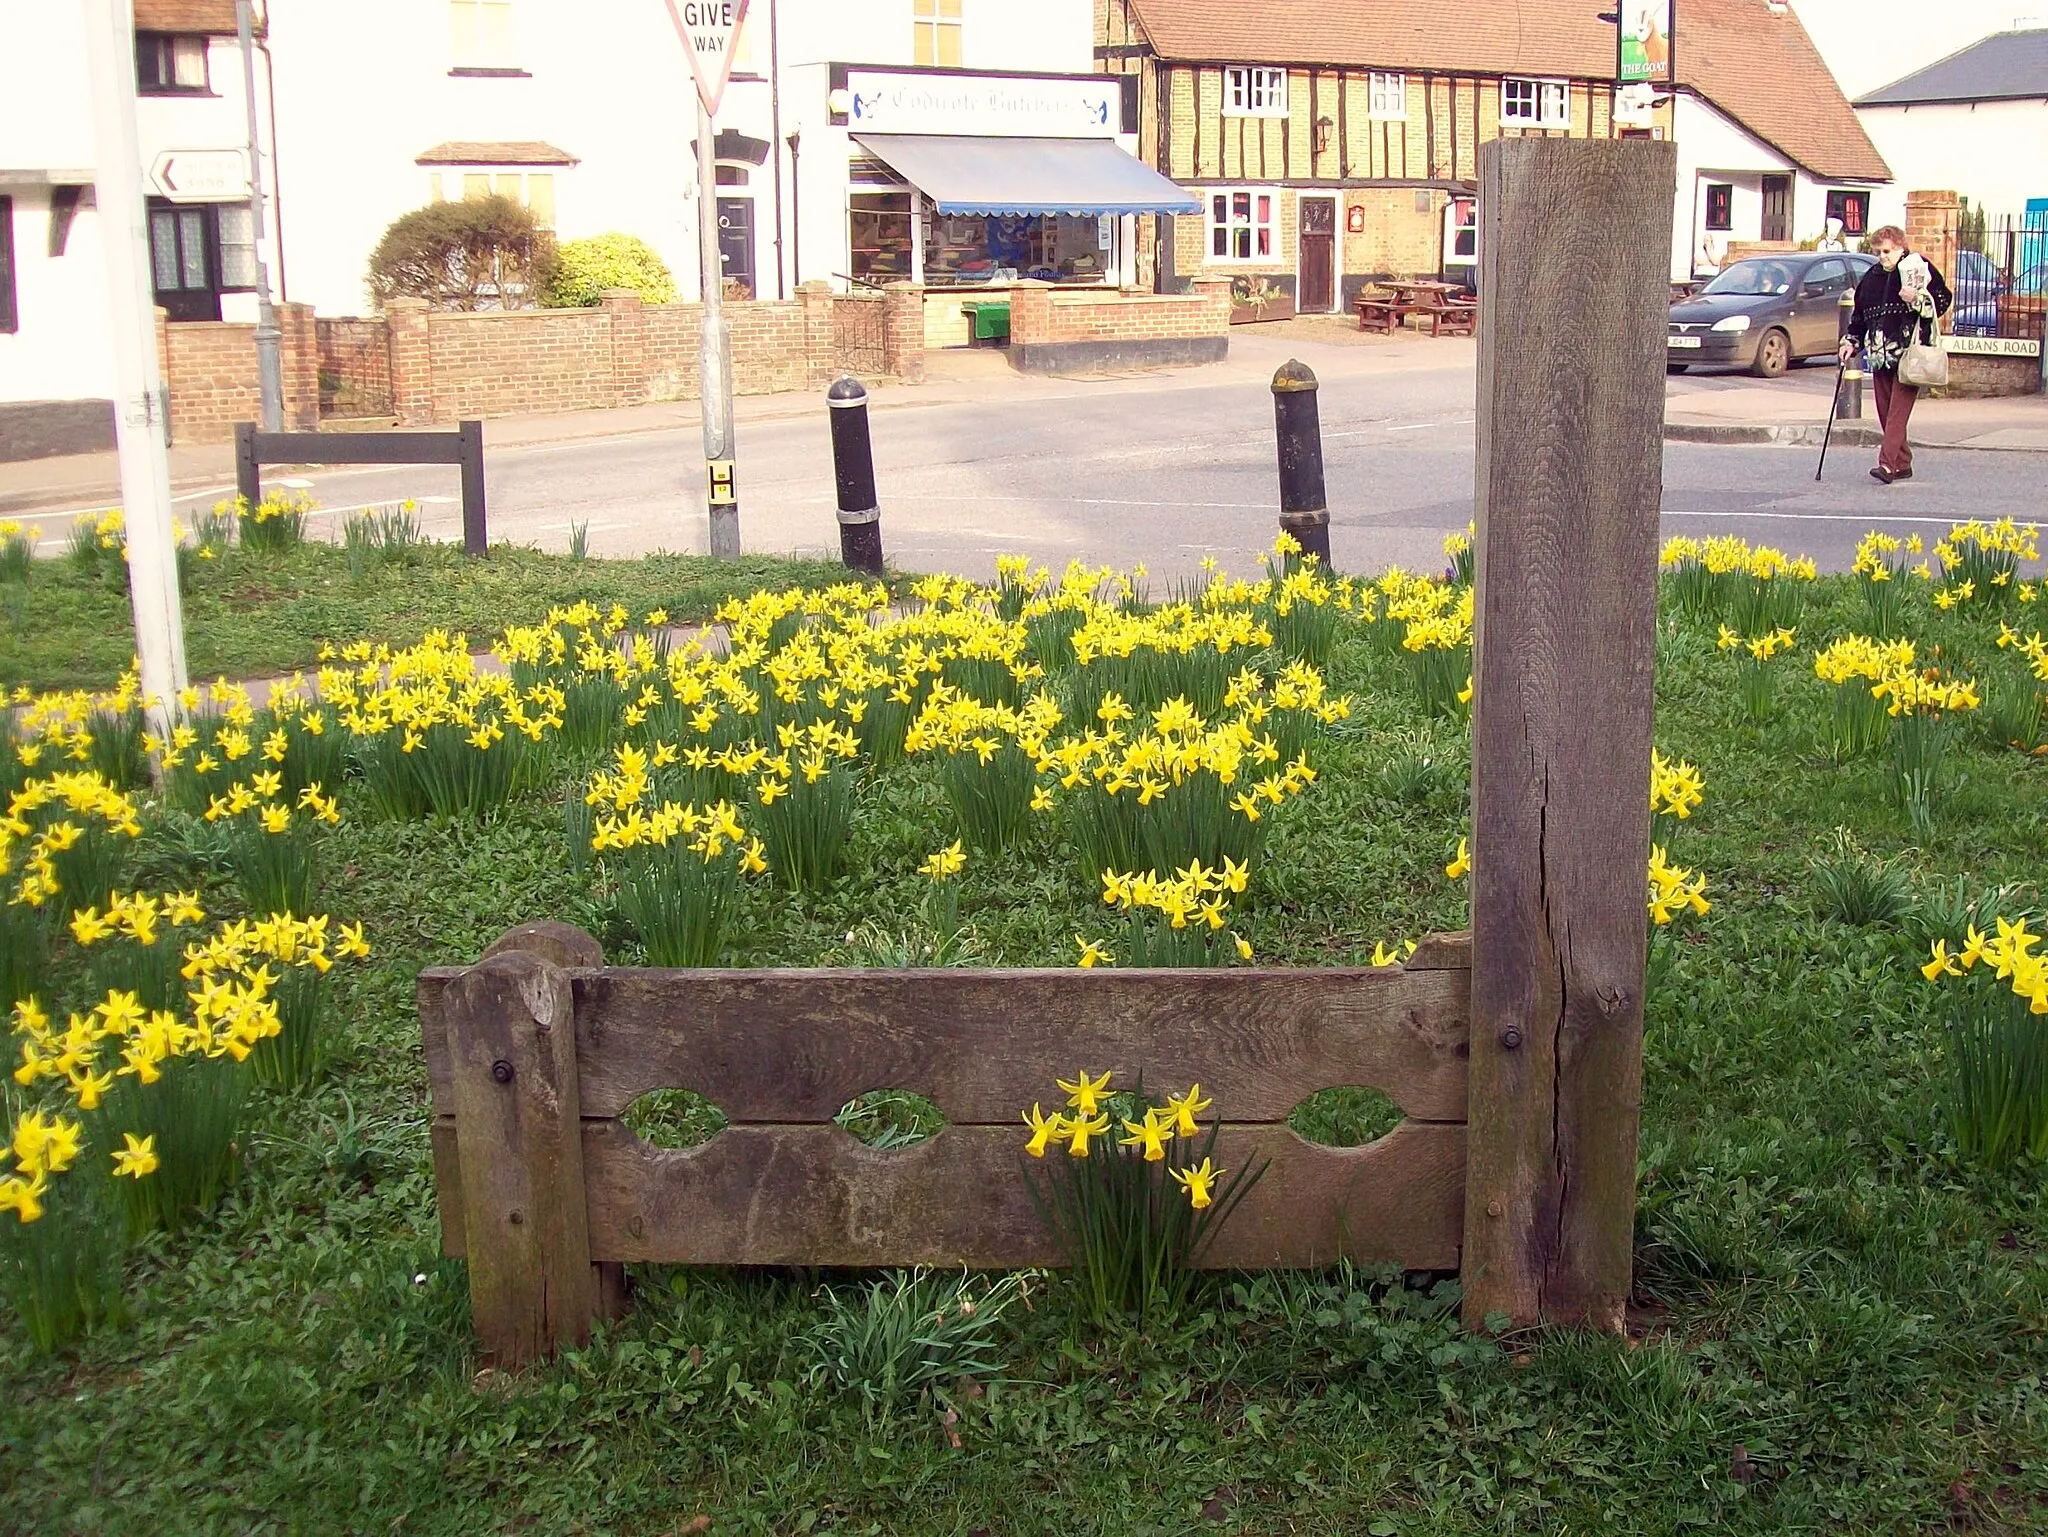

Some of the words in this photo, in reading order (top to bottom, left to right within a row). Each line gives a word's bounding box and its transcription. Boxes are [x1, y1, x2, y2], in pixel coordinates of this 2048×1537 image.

[684, 2, 732, 27] GIVE
[694, 35, 725, 52] WAY
[1622, 63, 1641, 75] THE
[1642, 61, 1667, 73] GOAT
[1952, 339, 1999, 353] ALBANS
[2003, 341, 2038, 355] ROAD
[709, 464, 735, 499] H
